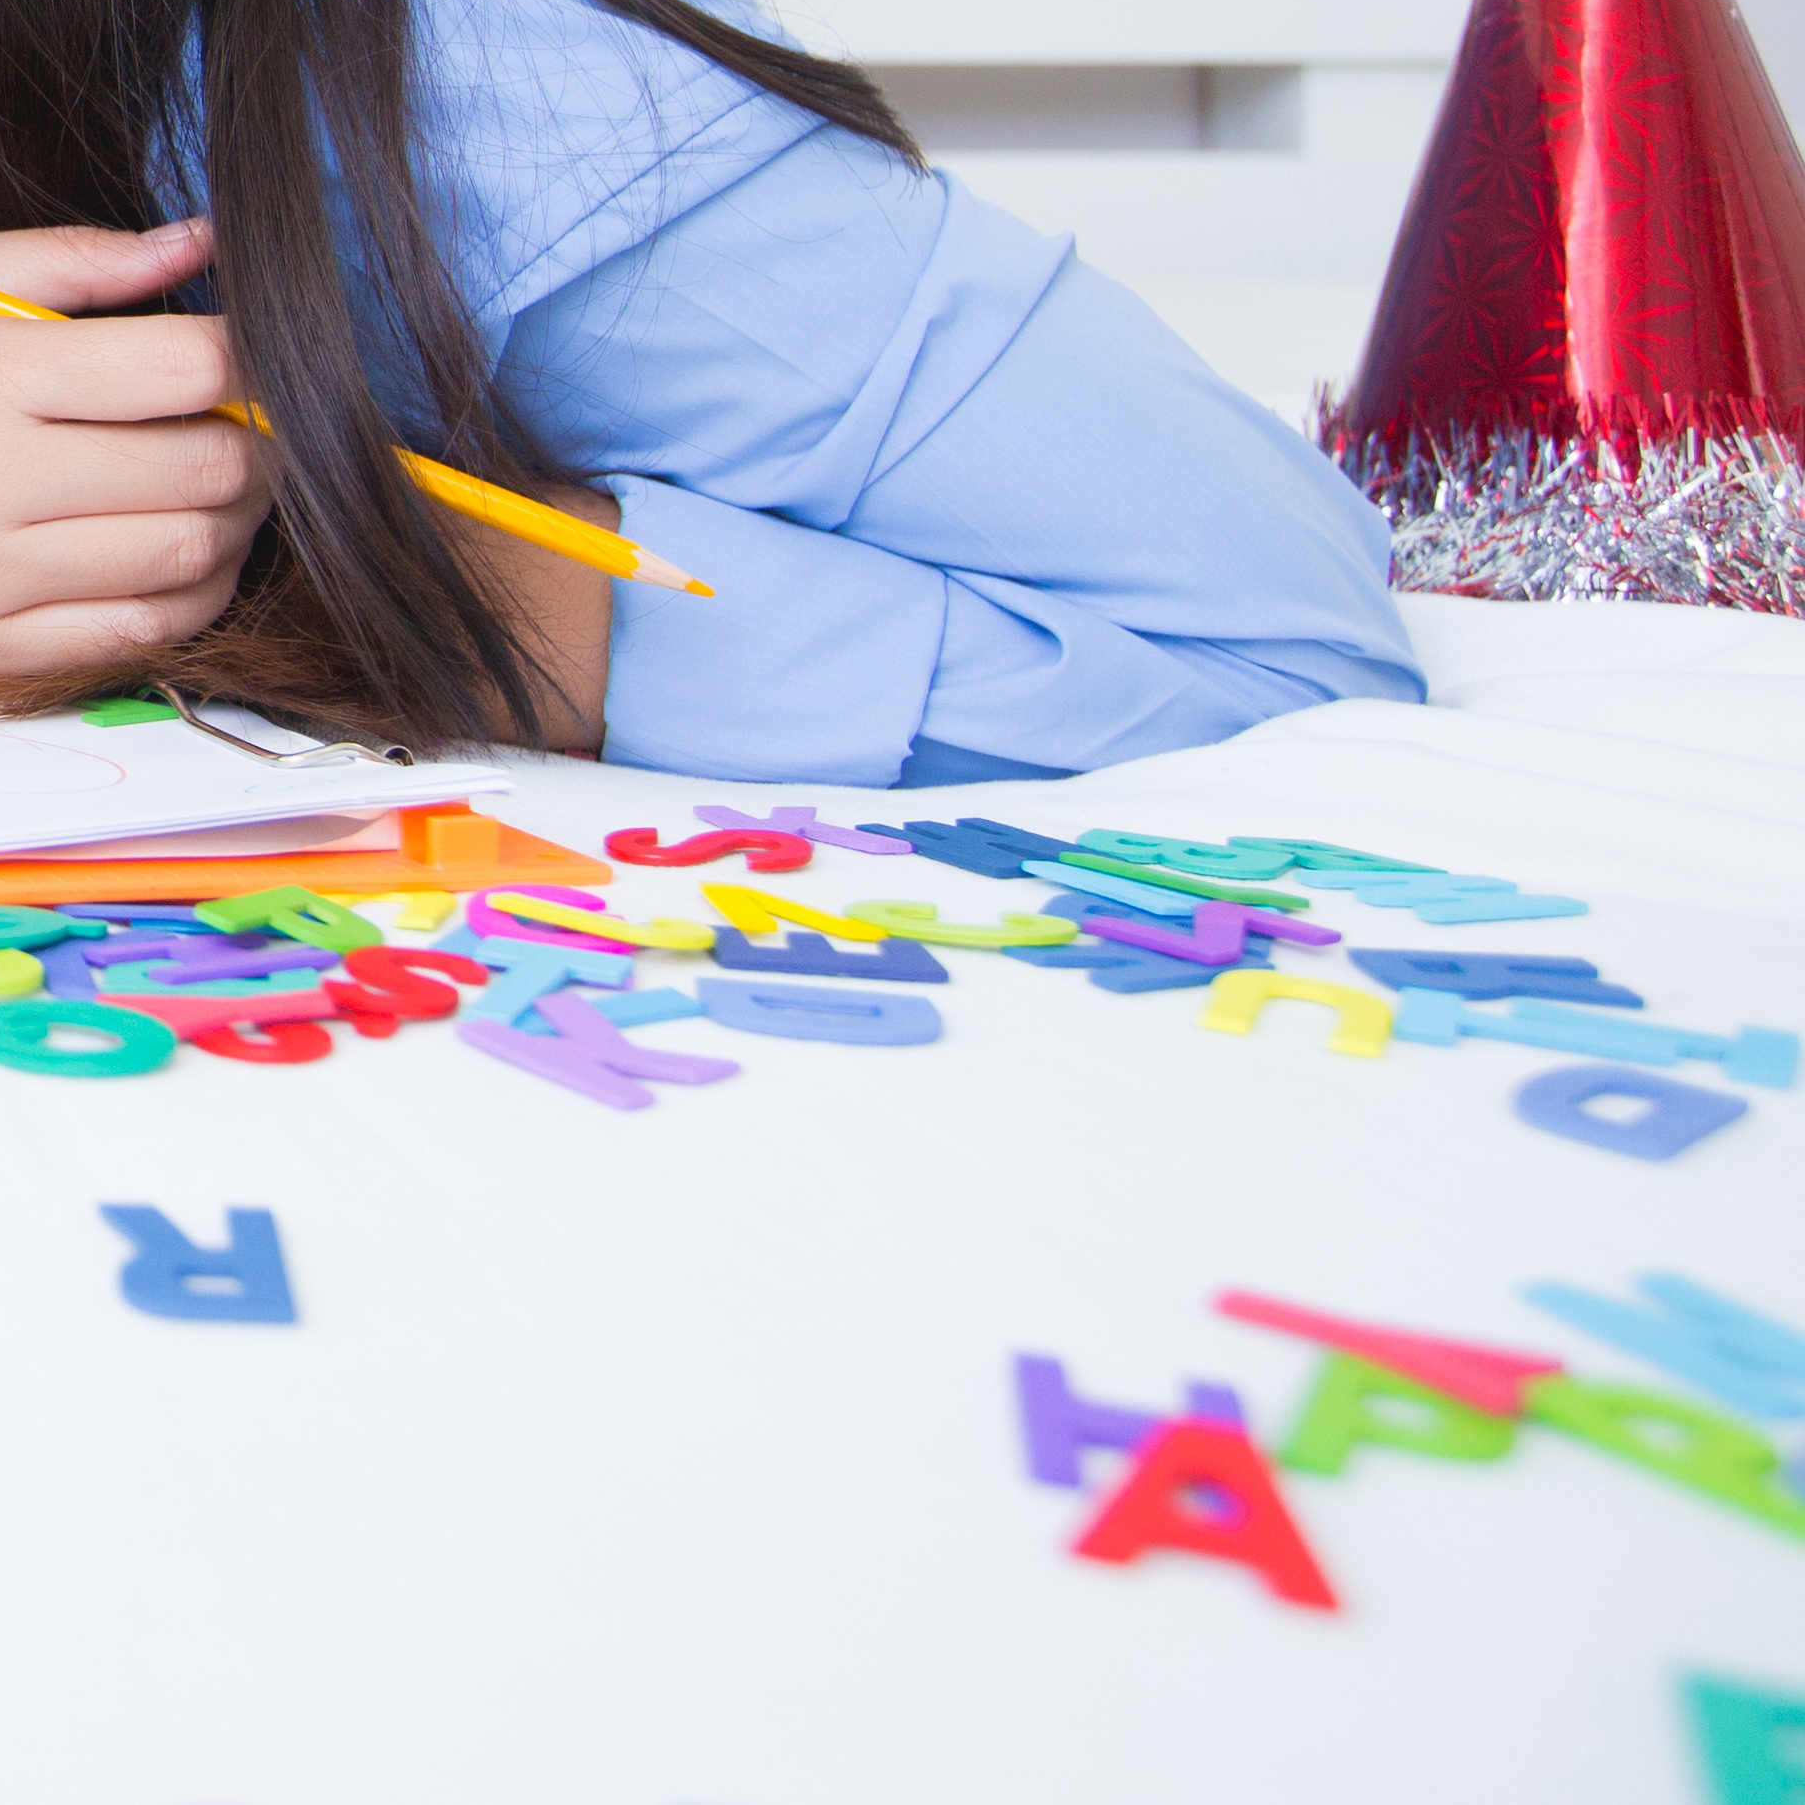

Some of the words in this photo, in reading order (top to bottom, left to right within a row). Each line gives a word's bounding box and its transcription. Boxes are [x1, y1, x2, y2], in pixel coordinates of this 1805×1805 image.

[605, 827, 813, 871] S
[96, 1203, 299, 1324] R
[1065, 1416, 1343, 1614] A
